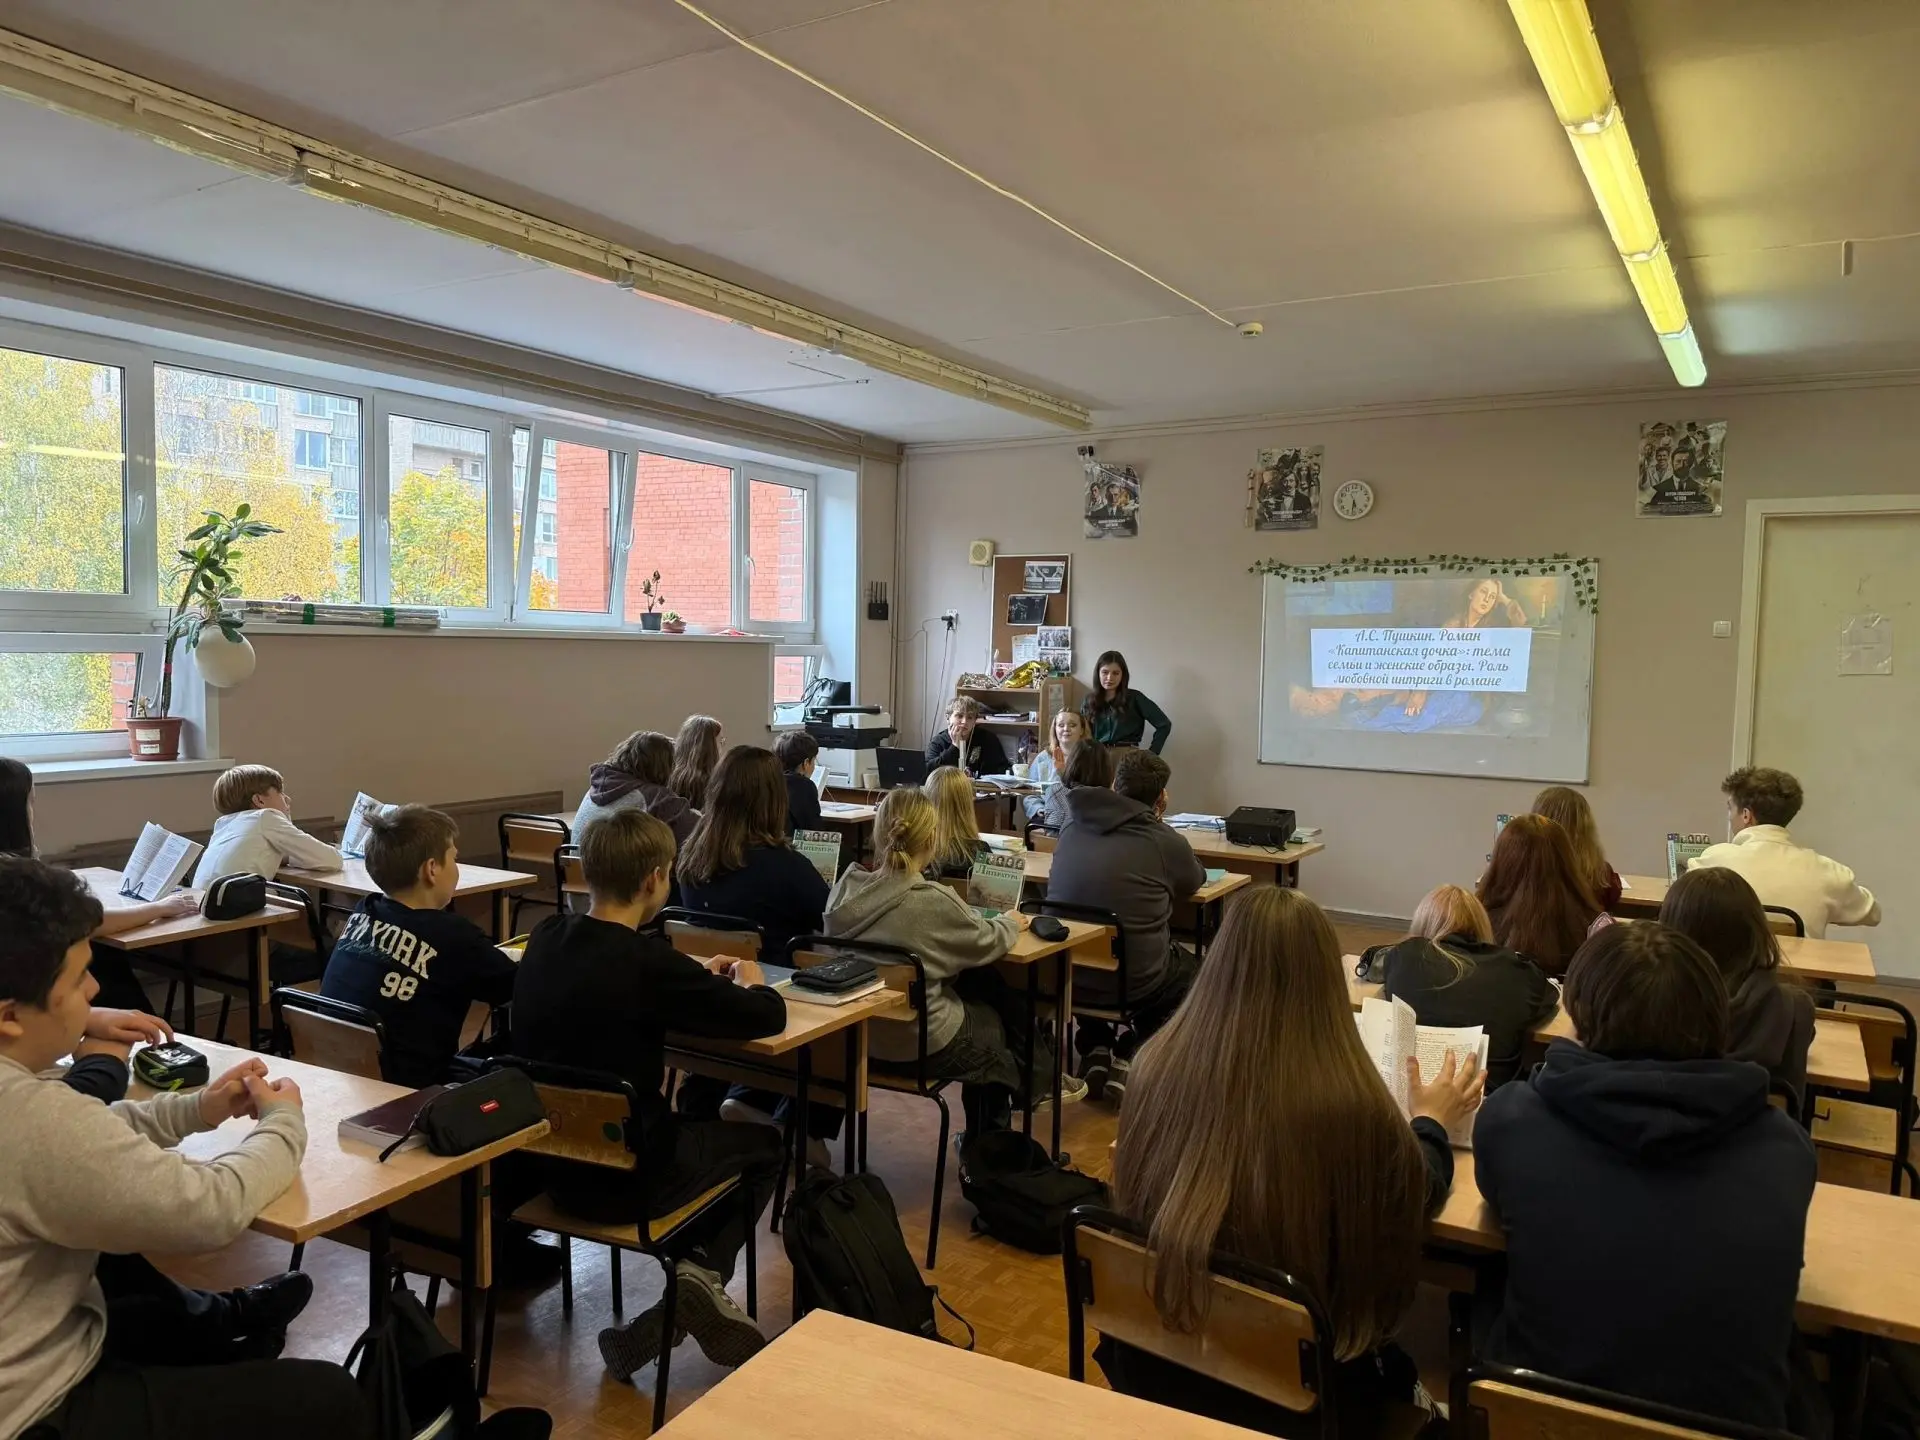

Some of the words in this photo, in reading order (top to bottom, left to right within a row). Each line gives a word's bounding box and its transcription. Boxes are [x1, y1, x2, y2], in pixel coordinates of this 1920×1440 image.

[1355, 629, 1379, 642] А.С.
[1383, 629, 1435, 644] Пушкин.
[1439, 629, 1481, 641] Роман
[1328, 644, 1418, 657] «Капитанская
[1421, 647, 1470, 660] дочка»:
[1472, 647, 1511, 657] тема
[1328, 660, 1363, 670] семьи
[1365, 662, 1372, 670] и
[1374, 661, 1426, 671] женские
[1428, 659, 1475, 675] образы.
[1478, 659, 1509, 671] Роль
[1333, 673, 1390, 685] любовной
[1391, 675, 1443, 688] интриги
[1445, 674, 1452, 685] в
[1454, 676, 1502, 688] романе
[339, 912, 371, 941] EW
[370, 919, 438, 980] YORK
[380, 971, 419, 1002] 98
